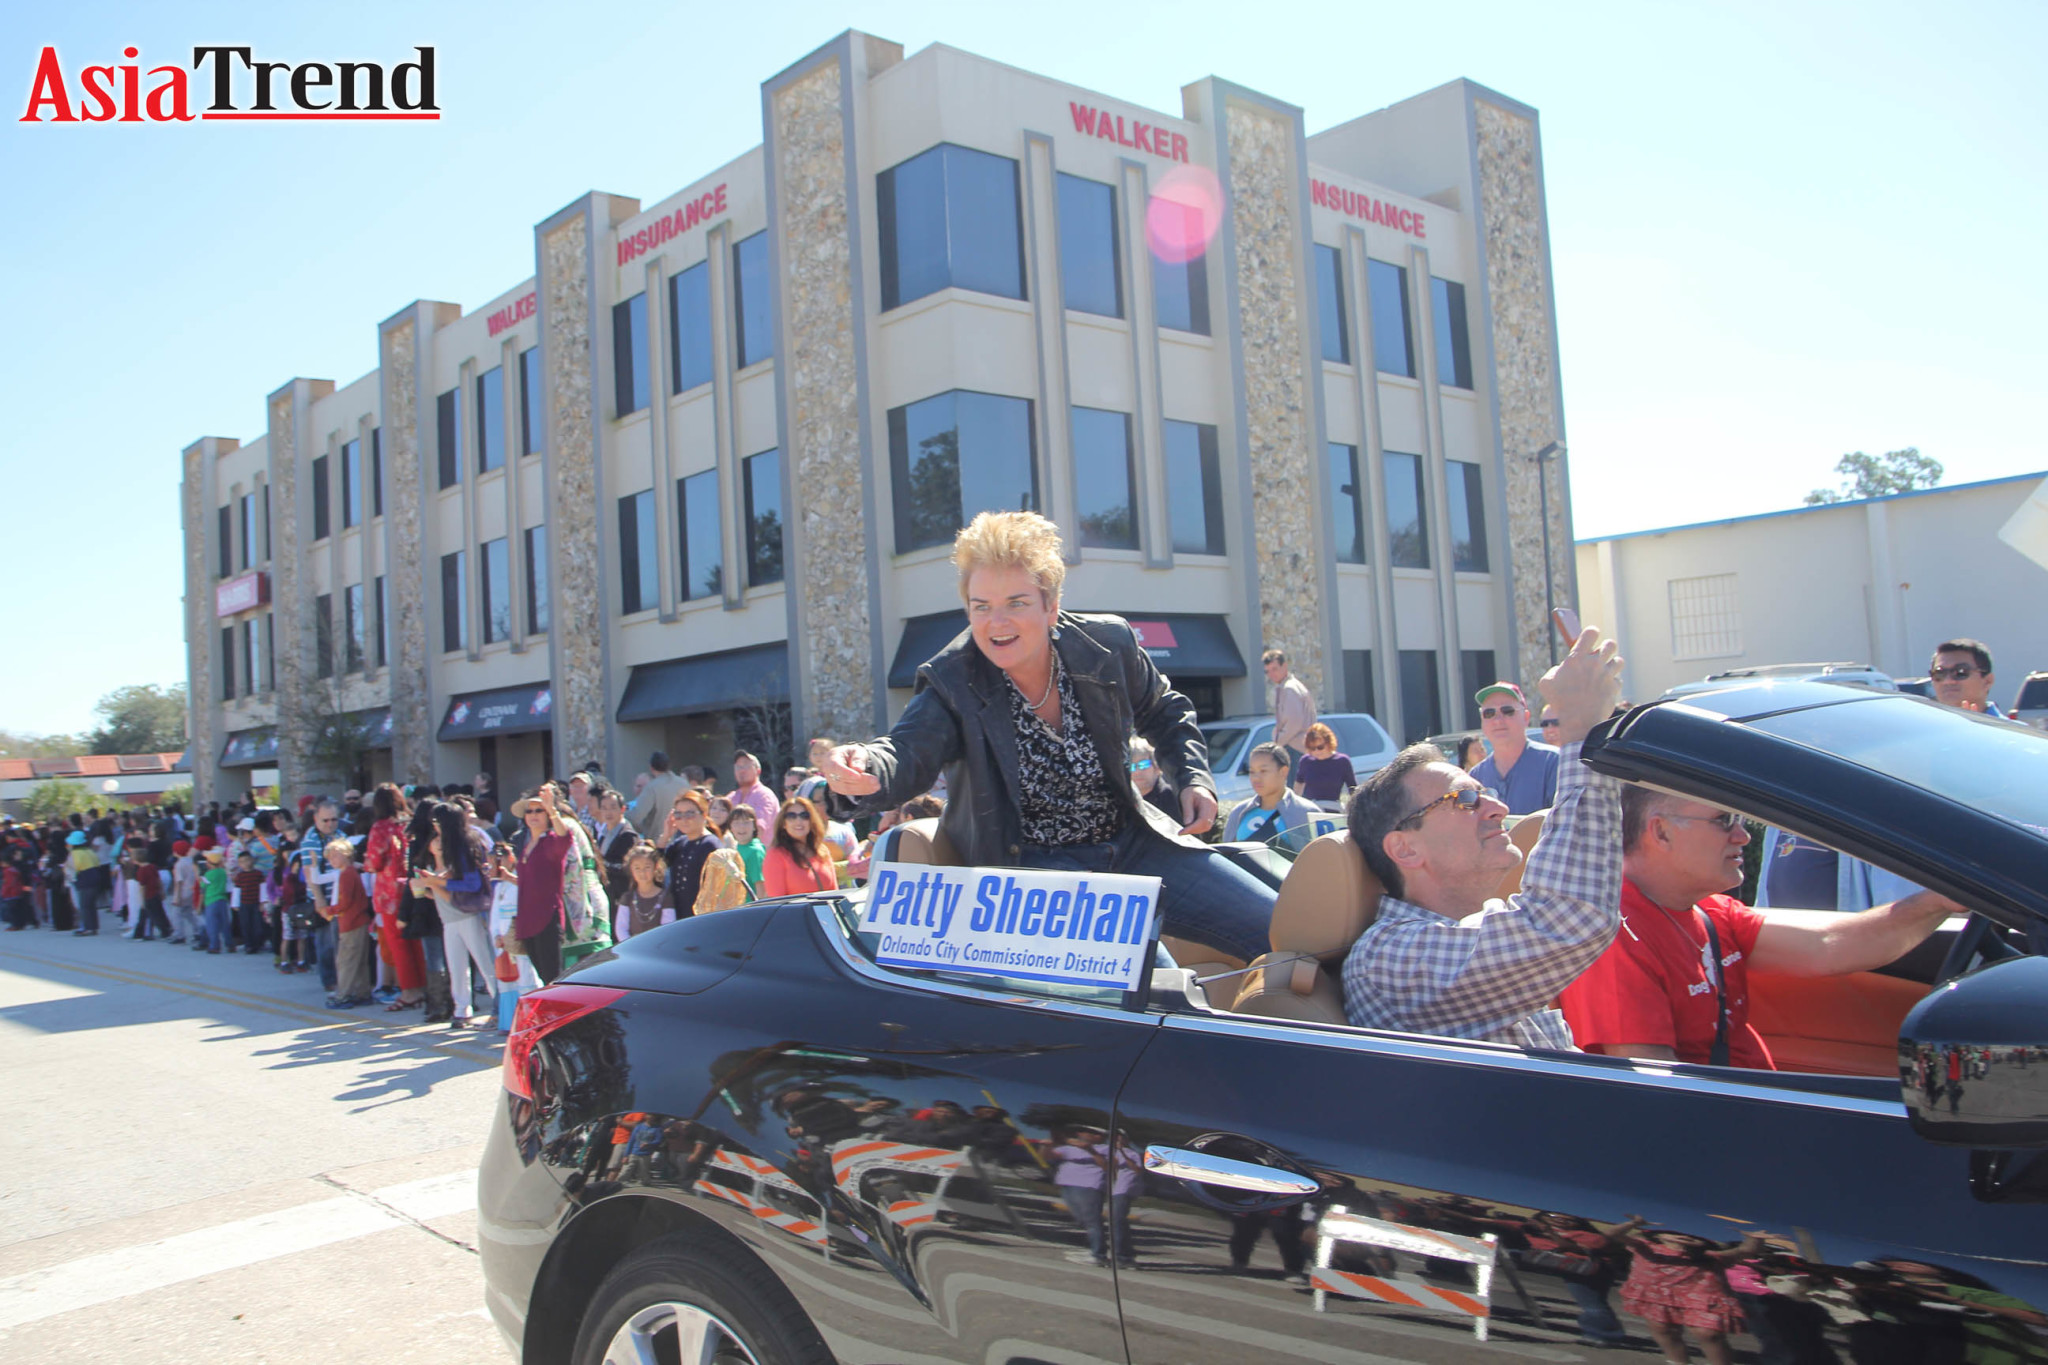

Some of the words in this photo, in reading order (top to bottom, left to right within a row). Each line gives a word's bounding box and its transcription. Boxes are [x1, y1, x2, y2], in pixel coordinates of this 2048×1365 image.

[1069, 101, 1189, 164] WALKER
[487, 292, 537, 337] WALKE
[617, 183, 728, 267] INSURANCE
[867, 869, 964, 939] Patty
[970, 874, 1150, 946] Sheehan
[882, 934, 932, 957] Orlando
[936, 940, 961, 963] City
[963, 942, 1061, 971] Commissioner
[1063, 951, 1119, 976] District
[1121, 956, 1133, 977] 4
